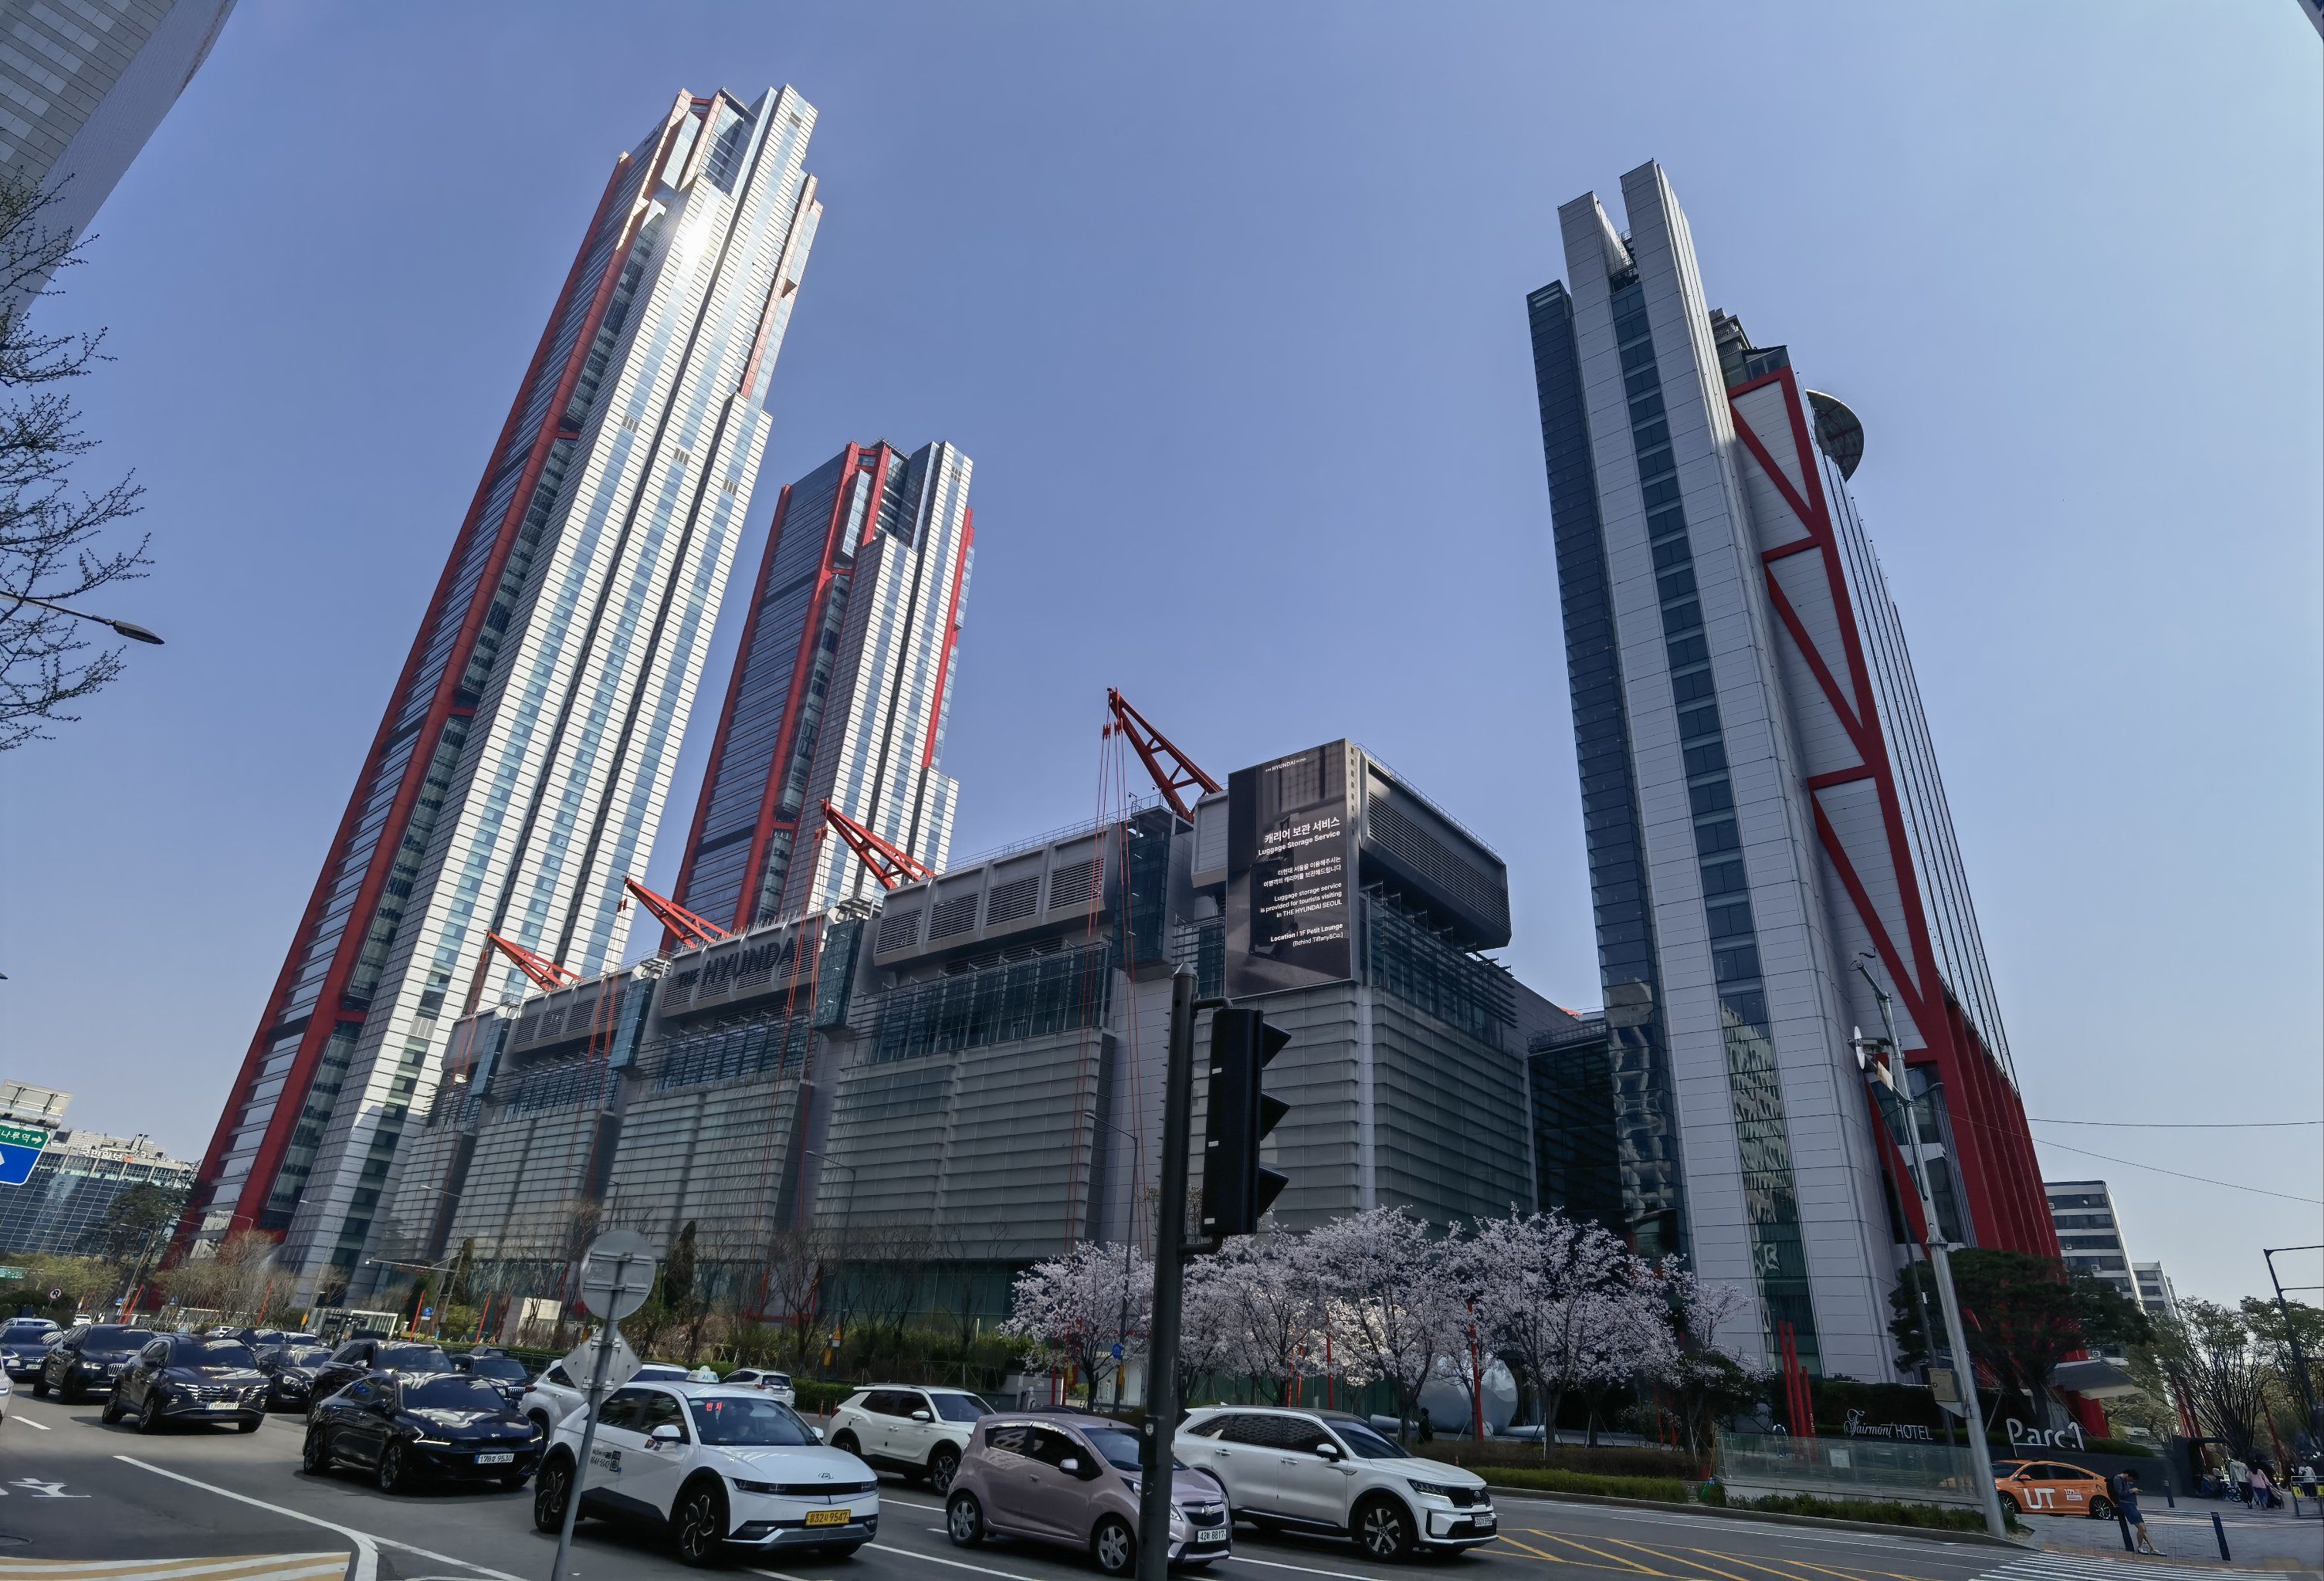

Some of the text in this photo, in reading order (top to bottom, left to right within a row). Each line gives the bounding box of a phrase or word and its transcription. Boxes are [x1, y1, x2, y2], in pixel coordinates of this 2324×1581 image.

[1272, 760, 1296, 771] HYUNDAI
[1265, 817, 1340, 844] 캐리어 보관 서비스
[1258, 830, 1340, 856] Luggage Storage Service
[1274, 882, 1342, 902] Luggage storage service
[1265, 902, 1289, 913] provided
[1299, 896, 1321, 905] tourists
[1321, 891, 1343, 900] visiting
[1295, 903, 1322, 915] HYUNDAI
[1322, 899, 1343, 909] SEOUL
[1271, 933, 1296, 942] Location
[1306, 927, 1320, 936] Petit
[1321, 923, 1343, 933] Lounge
[1292, 938, 1312, 947] (Behind
[0, 1129, 31, 1143] 나루역
[1844, 1408, 1895, 1438] Fairmont
[1895, 1424, 1933, 1441] HOTEL
[2006, 1417, 2085, 1451] Parc.1
[2023, 1488, 2055, 1508] UT
[829, 1512, 848, 1522] 9547
[1211, 1530, 1225, 1540] 8817
